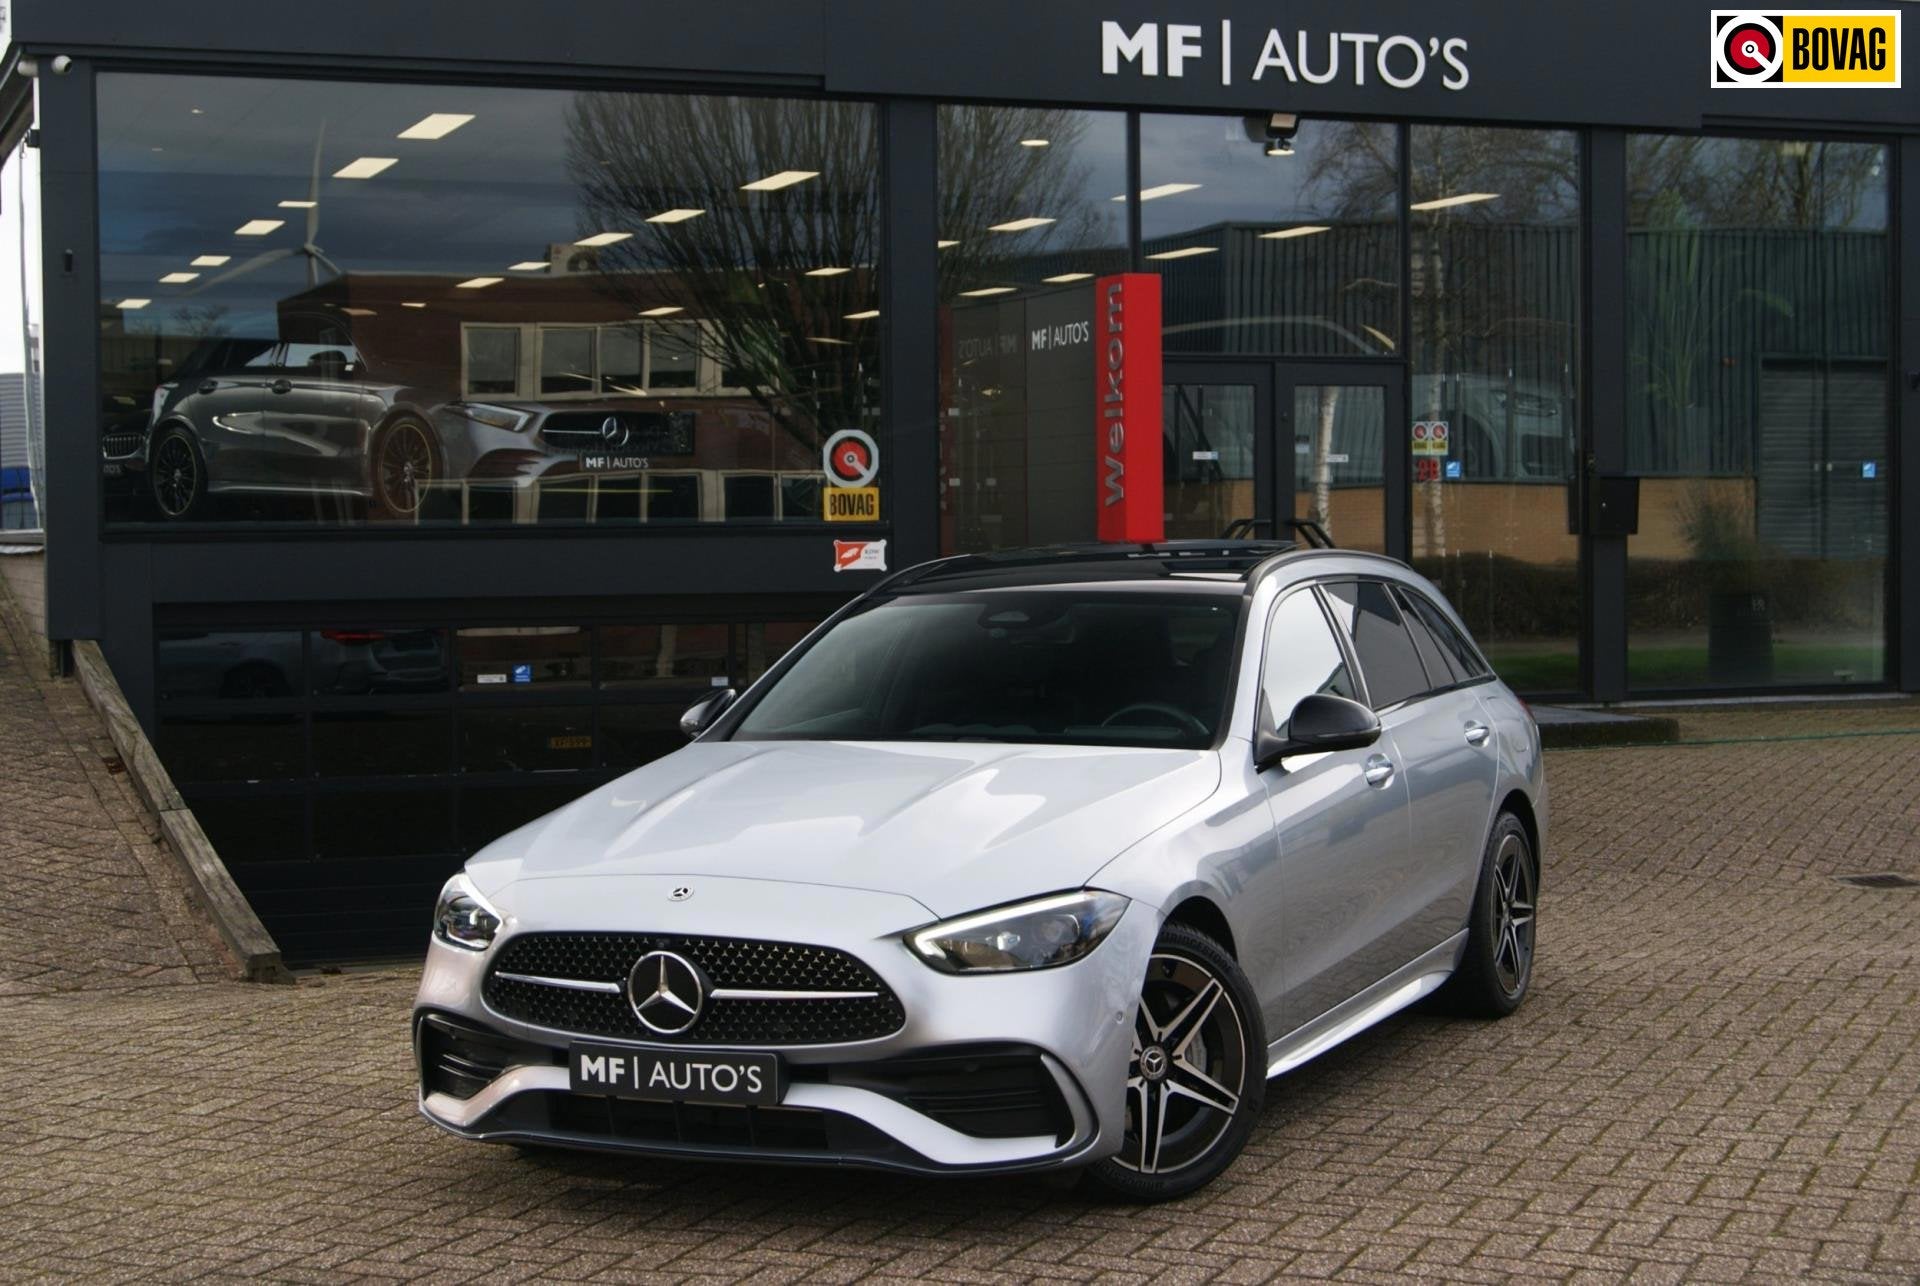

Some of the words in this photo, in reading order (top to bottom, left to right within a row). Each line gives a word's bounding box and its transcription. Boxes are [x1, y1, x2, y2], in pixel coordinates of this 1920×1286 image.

[1102, 20, 1201, 77] MF
[1252, 28, 1470, 90] AUTO'S
[1031, 328, 1047, 350] MF
[1053, 320, 1089, 347] AUTO'S
[585, 456, 605, 469] MF
[612, 456, 649, 469] AUTO'S
[829, 493, 875, 516] BOVAG
[580, 1054, 625, 1084] MF
[649, 1060, 763, 1094] AUTO'S
